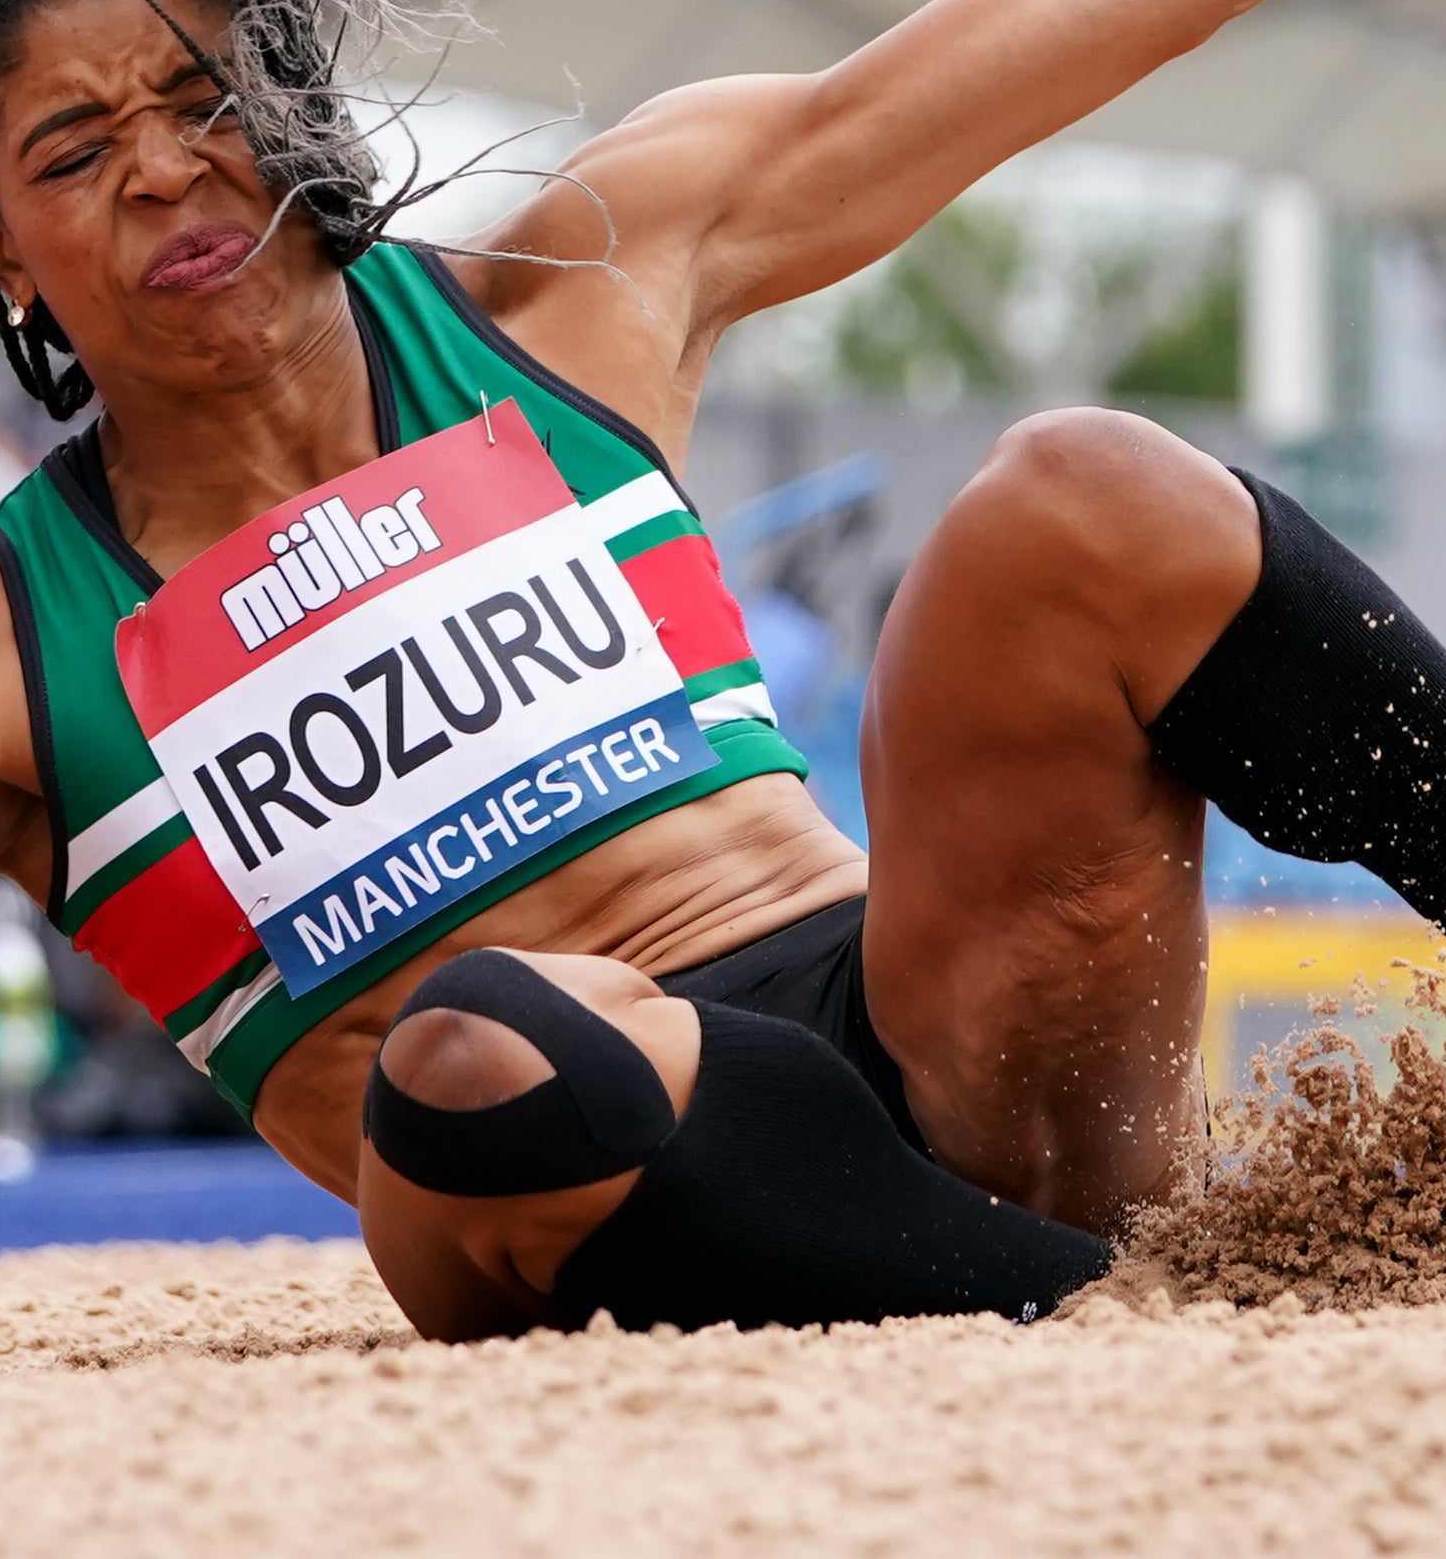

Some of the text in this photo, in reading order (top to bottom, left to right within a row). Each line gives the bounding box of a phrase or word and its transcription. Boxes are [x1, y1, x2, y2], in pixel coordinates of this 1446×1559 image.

[220, 486, 443, 653] müller
[193, 558, 626, 870] IROZURU
[293, 717, 679, 965] MANCHESTER
